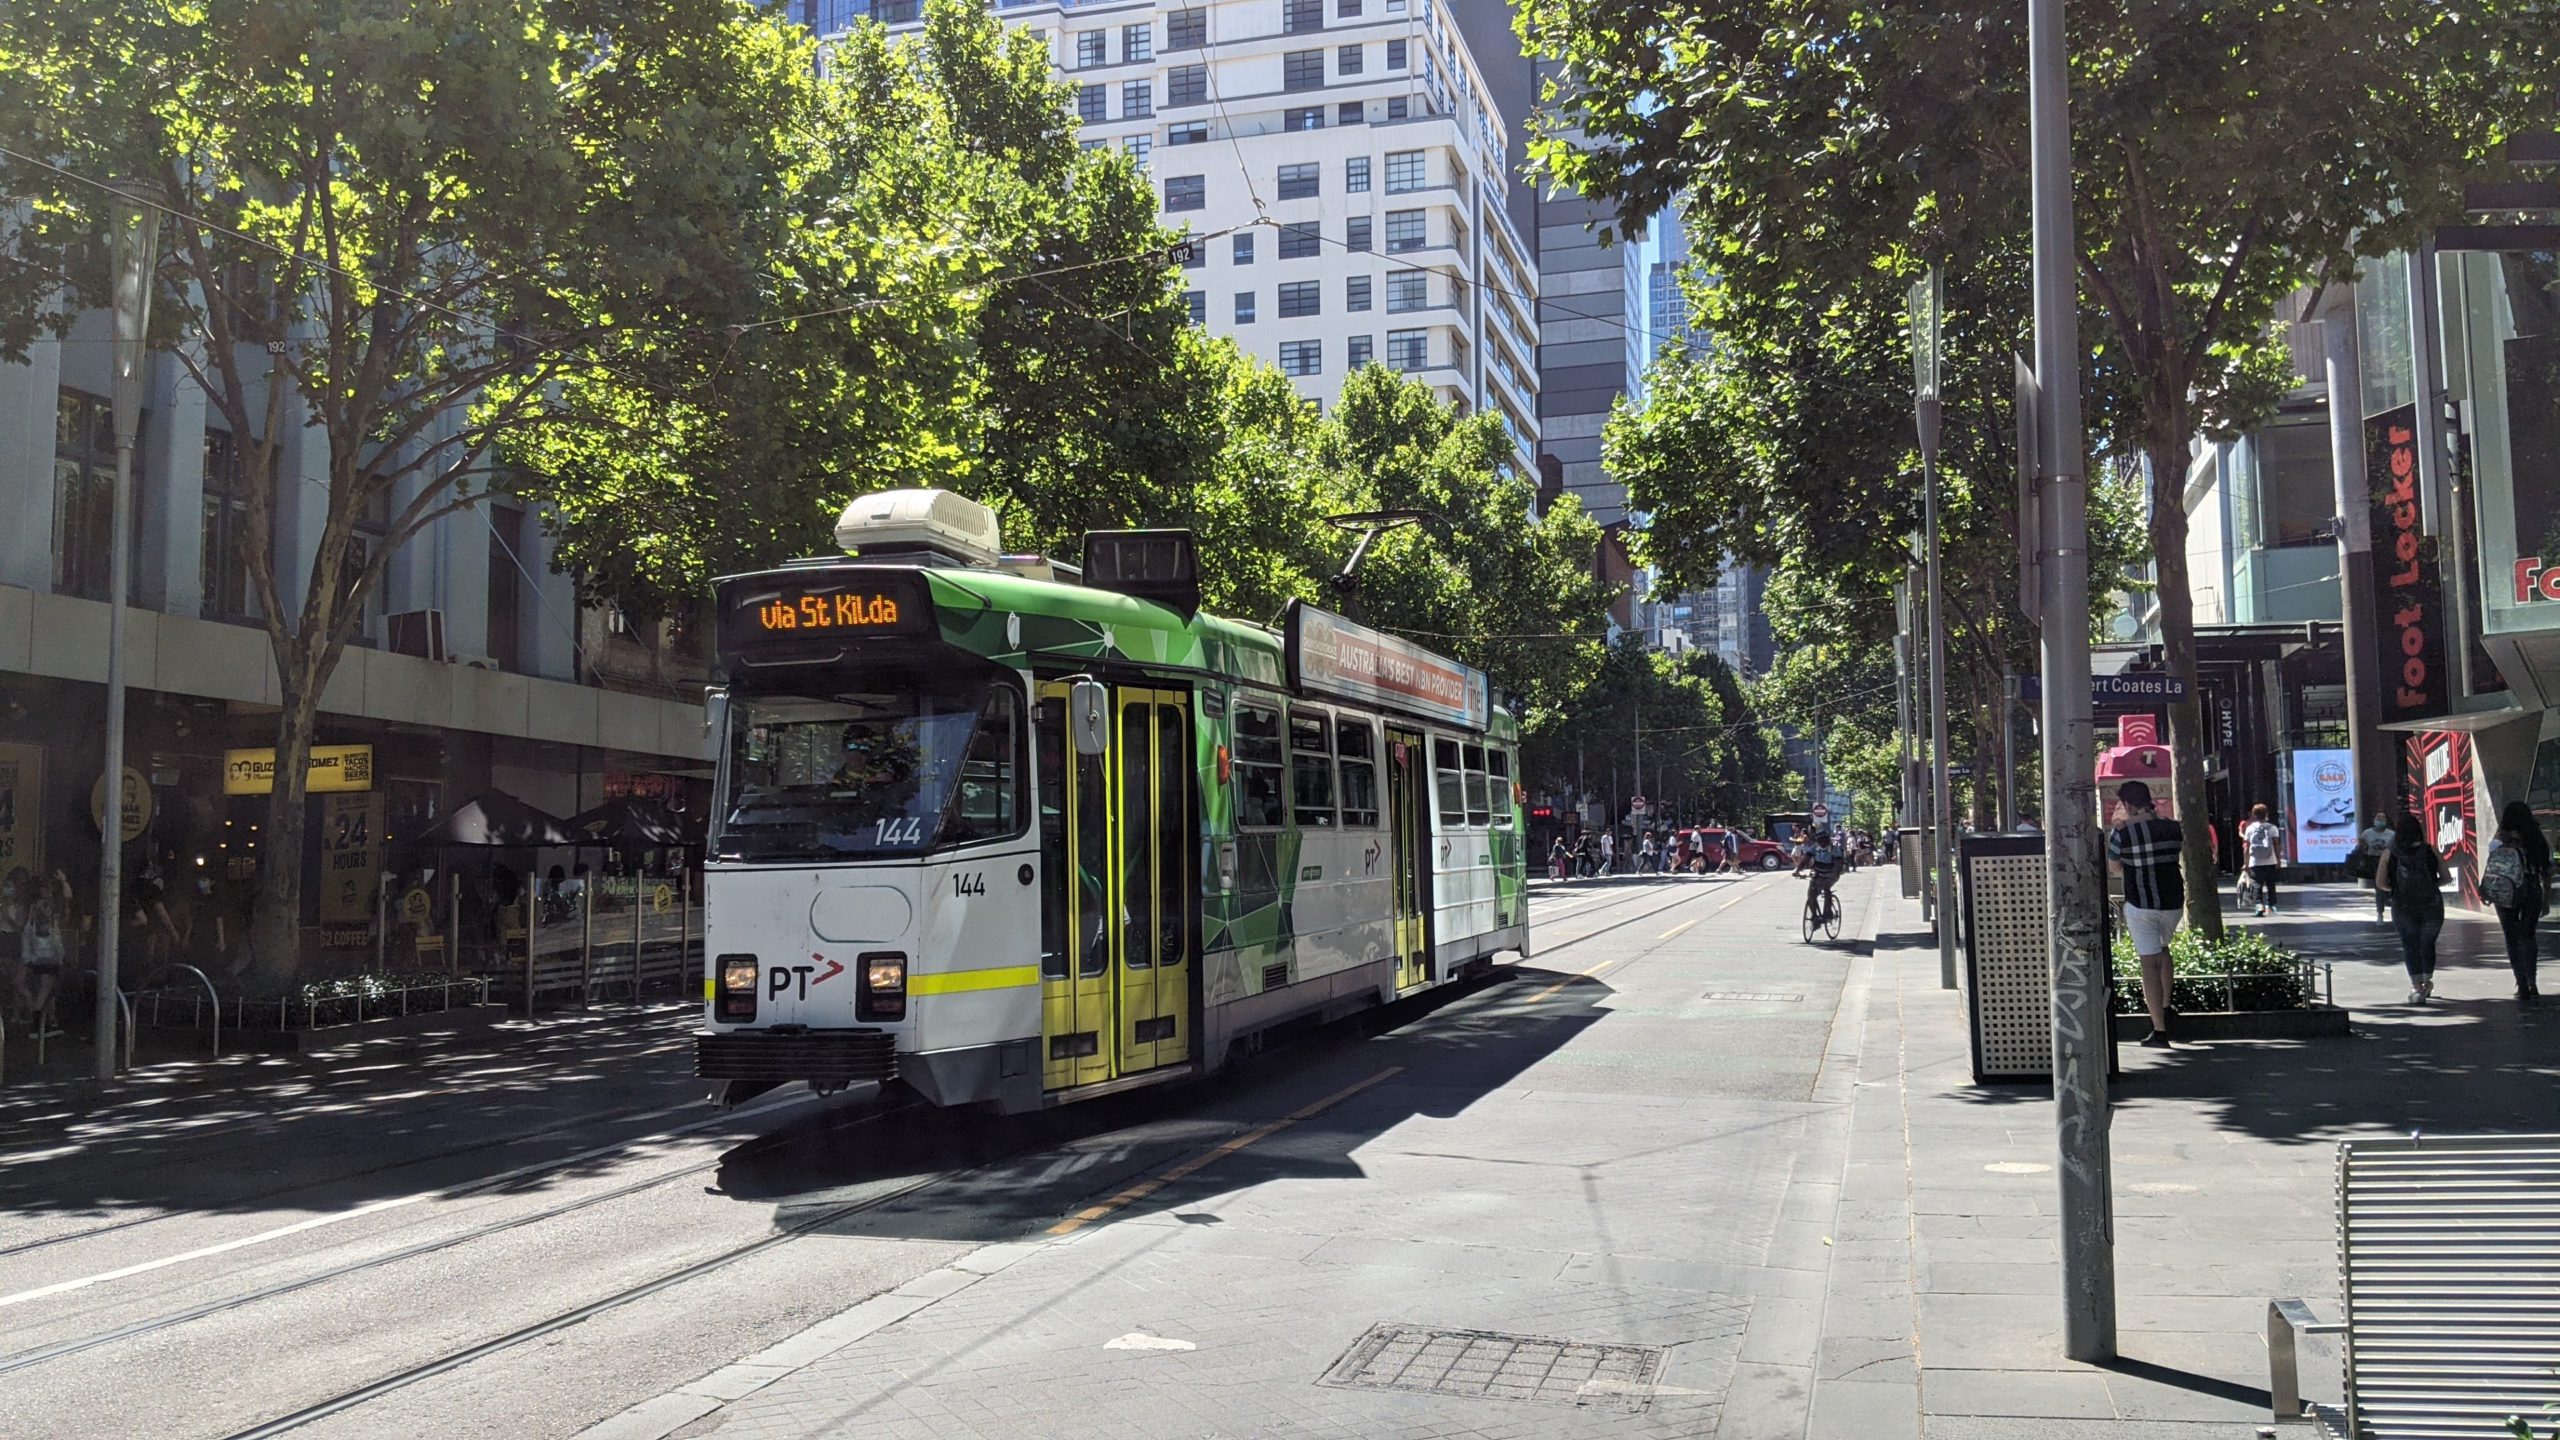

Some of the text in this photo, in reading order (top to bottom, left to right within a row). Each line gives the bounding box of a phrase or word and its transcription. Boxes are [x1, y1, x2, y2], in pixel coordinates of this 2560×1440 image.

[1172, 248, 1190, 263] 192
[268, 341, 286, 353] 192
[2384, 424, 2428, 708] Foot Locker
[762, 595, 898, 629] via St Kilda
[1339, 643, 1394, 681] AUSTRALIA'S
[1395, 661, 1415, 687] BEST
[1415, 667, 1431, 692] NBN
[1431, 672, 1463, 702] PROVIDER
[2111, 677, 2162, 694] Coates
[2165, 679, 2182, 694] La
[2221, 710, 2233, 747] HYPE
[344, 758, 369, 766] TACOS
[335, 813, 368, 850] 24
[875, 817, 921, 846] 144
[333, 851, 368, 870] HOURS
[1365, 848, 1375, 876] PT
[1441, 845, 1448, 868] PT
[953, 872, 986, 898] 144
[335, 930, 370, 946] COFFEE
[769, 966, 815, 1002] PT
